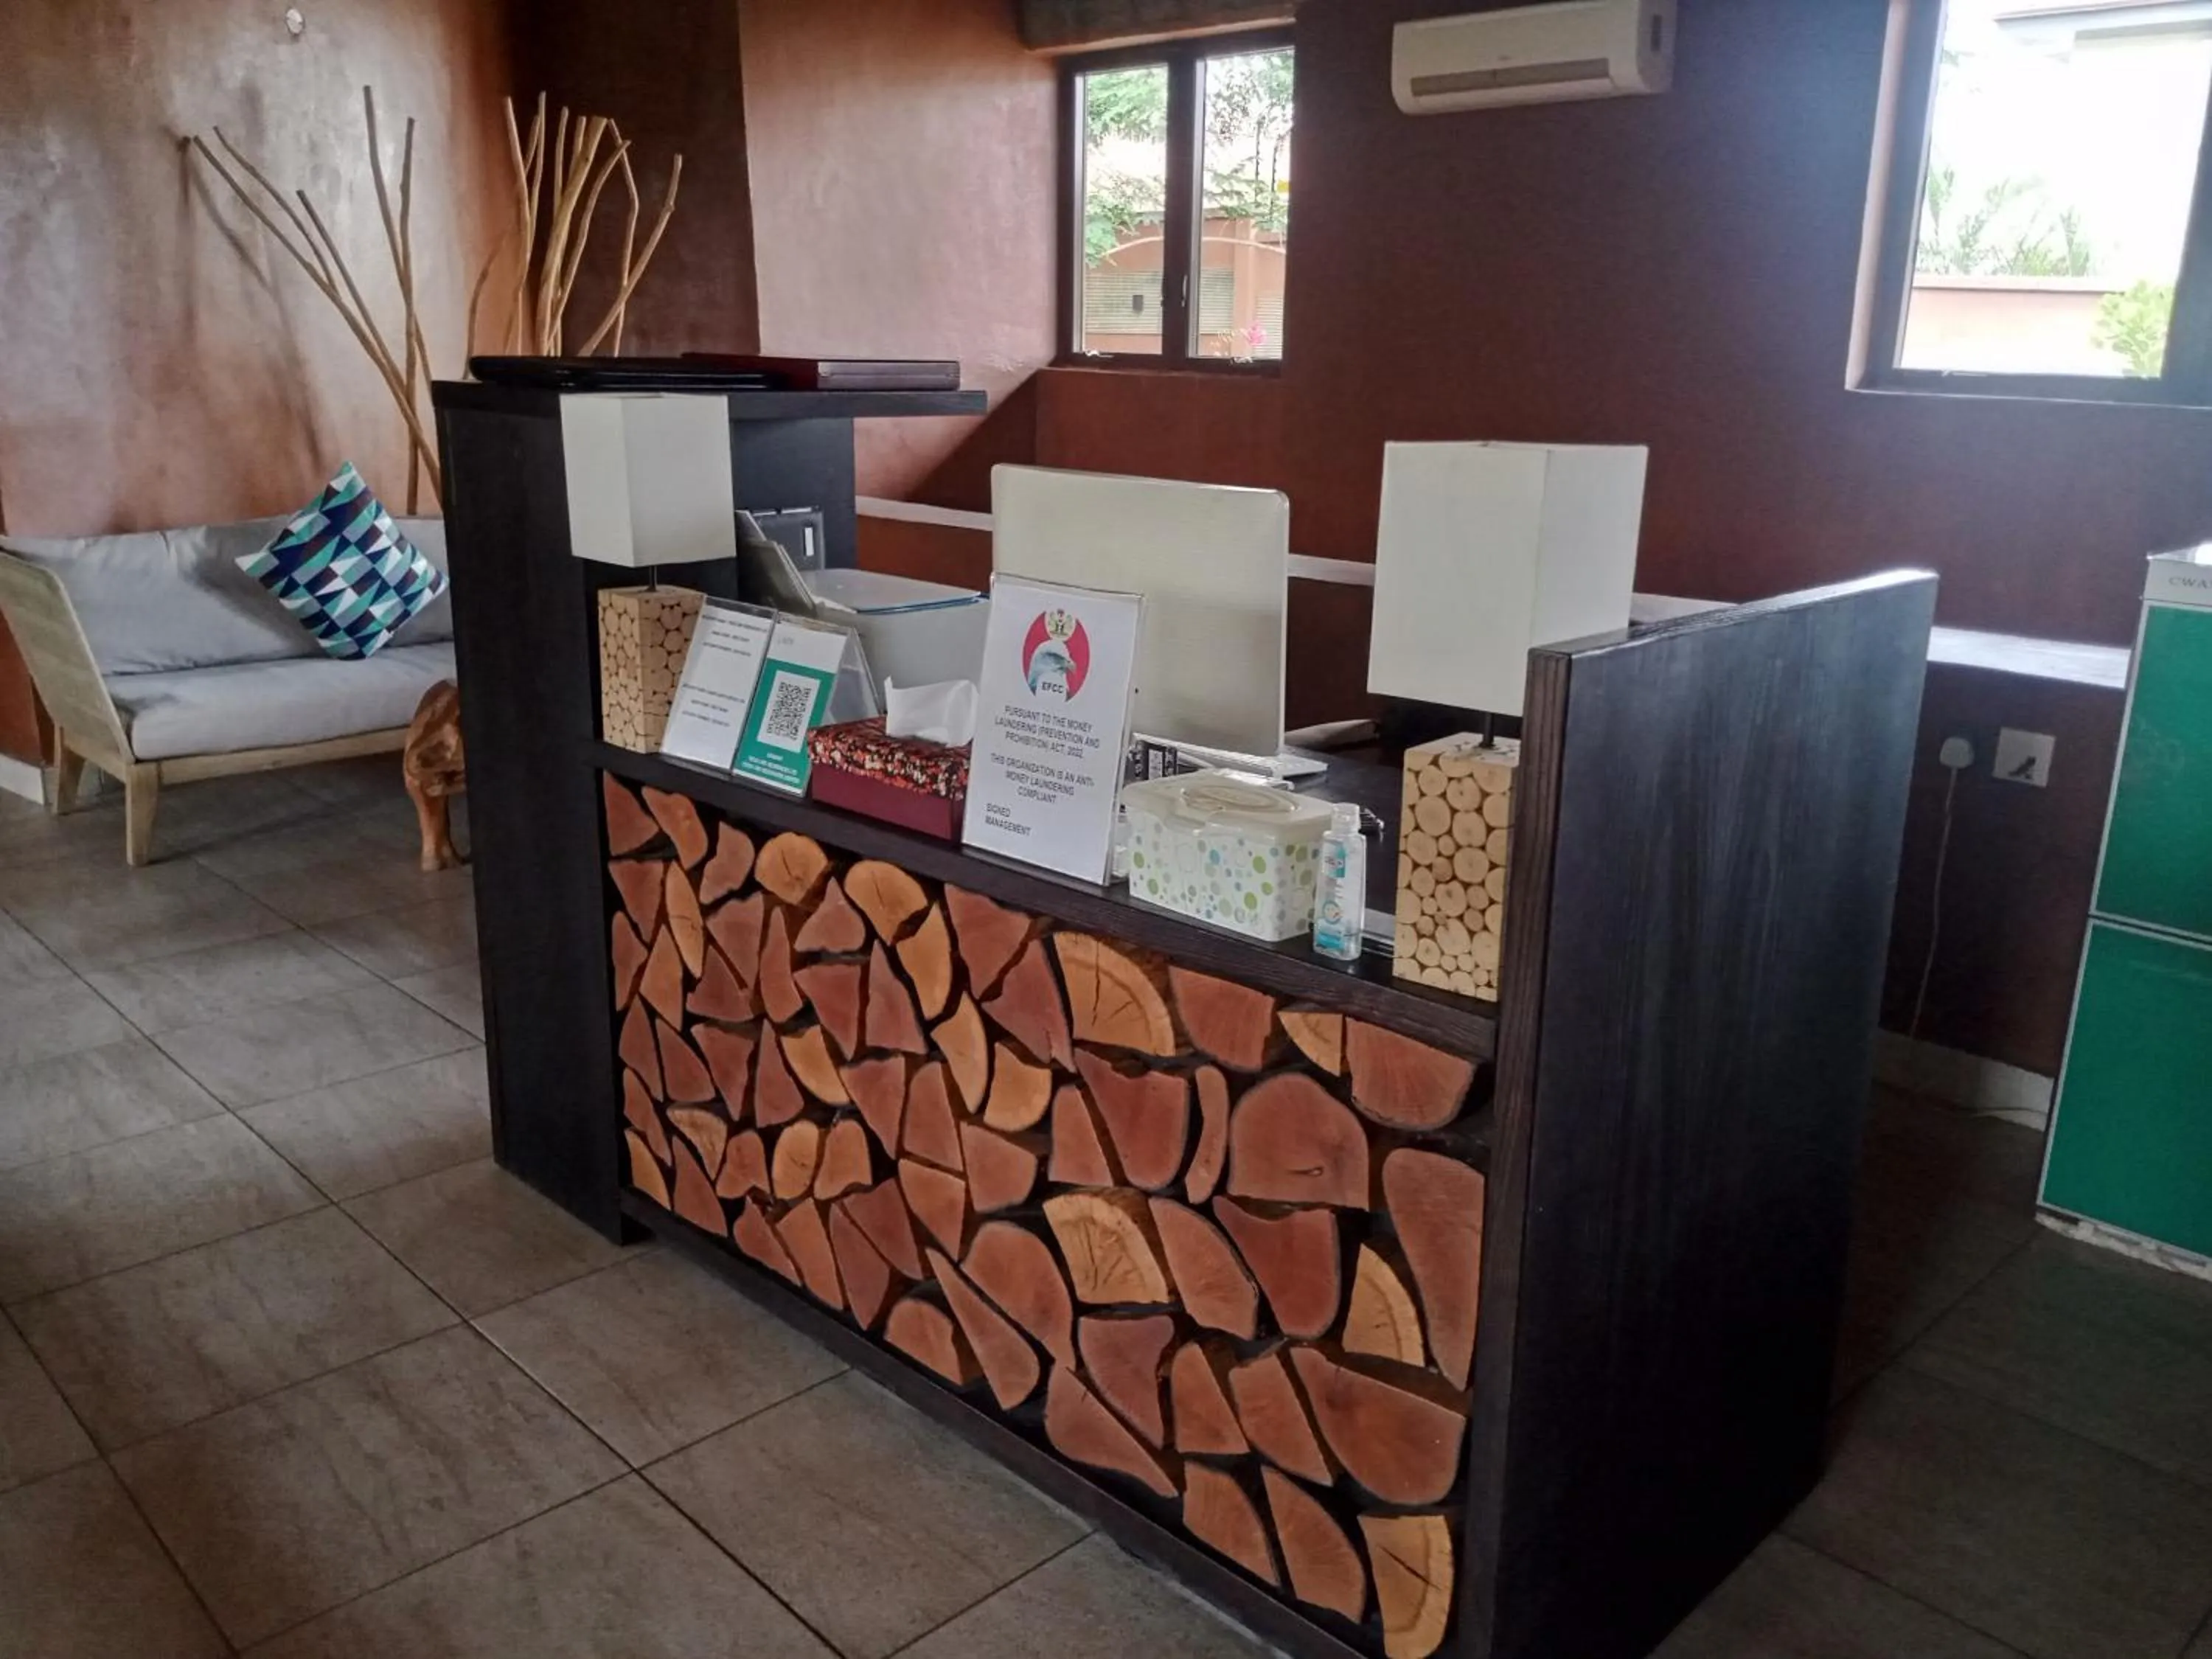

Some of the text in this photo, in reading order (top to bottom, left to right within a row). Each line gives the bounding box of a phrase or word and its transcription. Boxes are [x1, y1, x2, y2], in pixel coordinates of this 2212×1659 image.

[2168, 576, 2212, 590] CWA
[1042, 681, 1064, 694] EFCC
[1005, 705, 1092, 732] PURSUANT TO THE MONEY
[995, 716, 1037, 734] LAUNDERING
[1083, 736, 1099, 749] AND
[990, 752, 1005, 765] THIS
[1006, 757, 1056, 778] ORGANIZATION
[1057, 771, 1063, 780] IS
[1064, 772, 1075, 783] AN
[1006, 770, 1074, 796] MONEY LAUNDERING
[1018, 785, 1057, 803] COMPLIANT
[987, 803, 1011, 818] SIGNED
[985, 815, 1032, 835] MANAGEMENT
